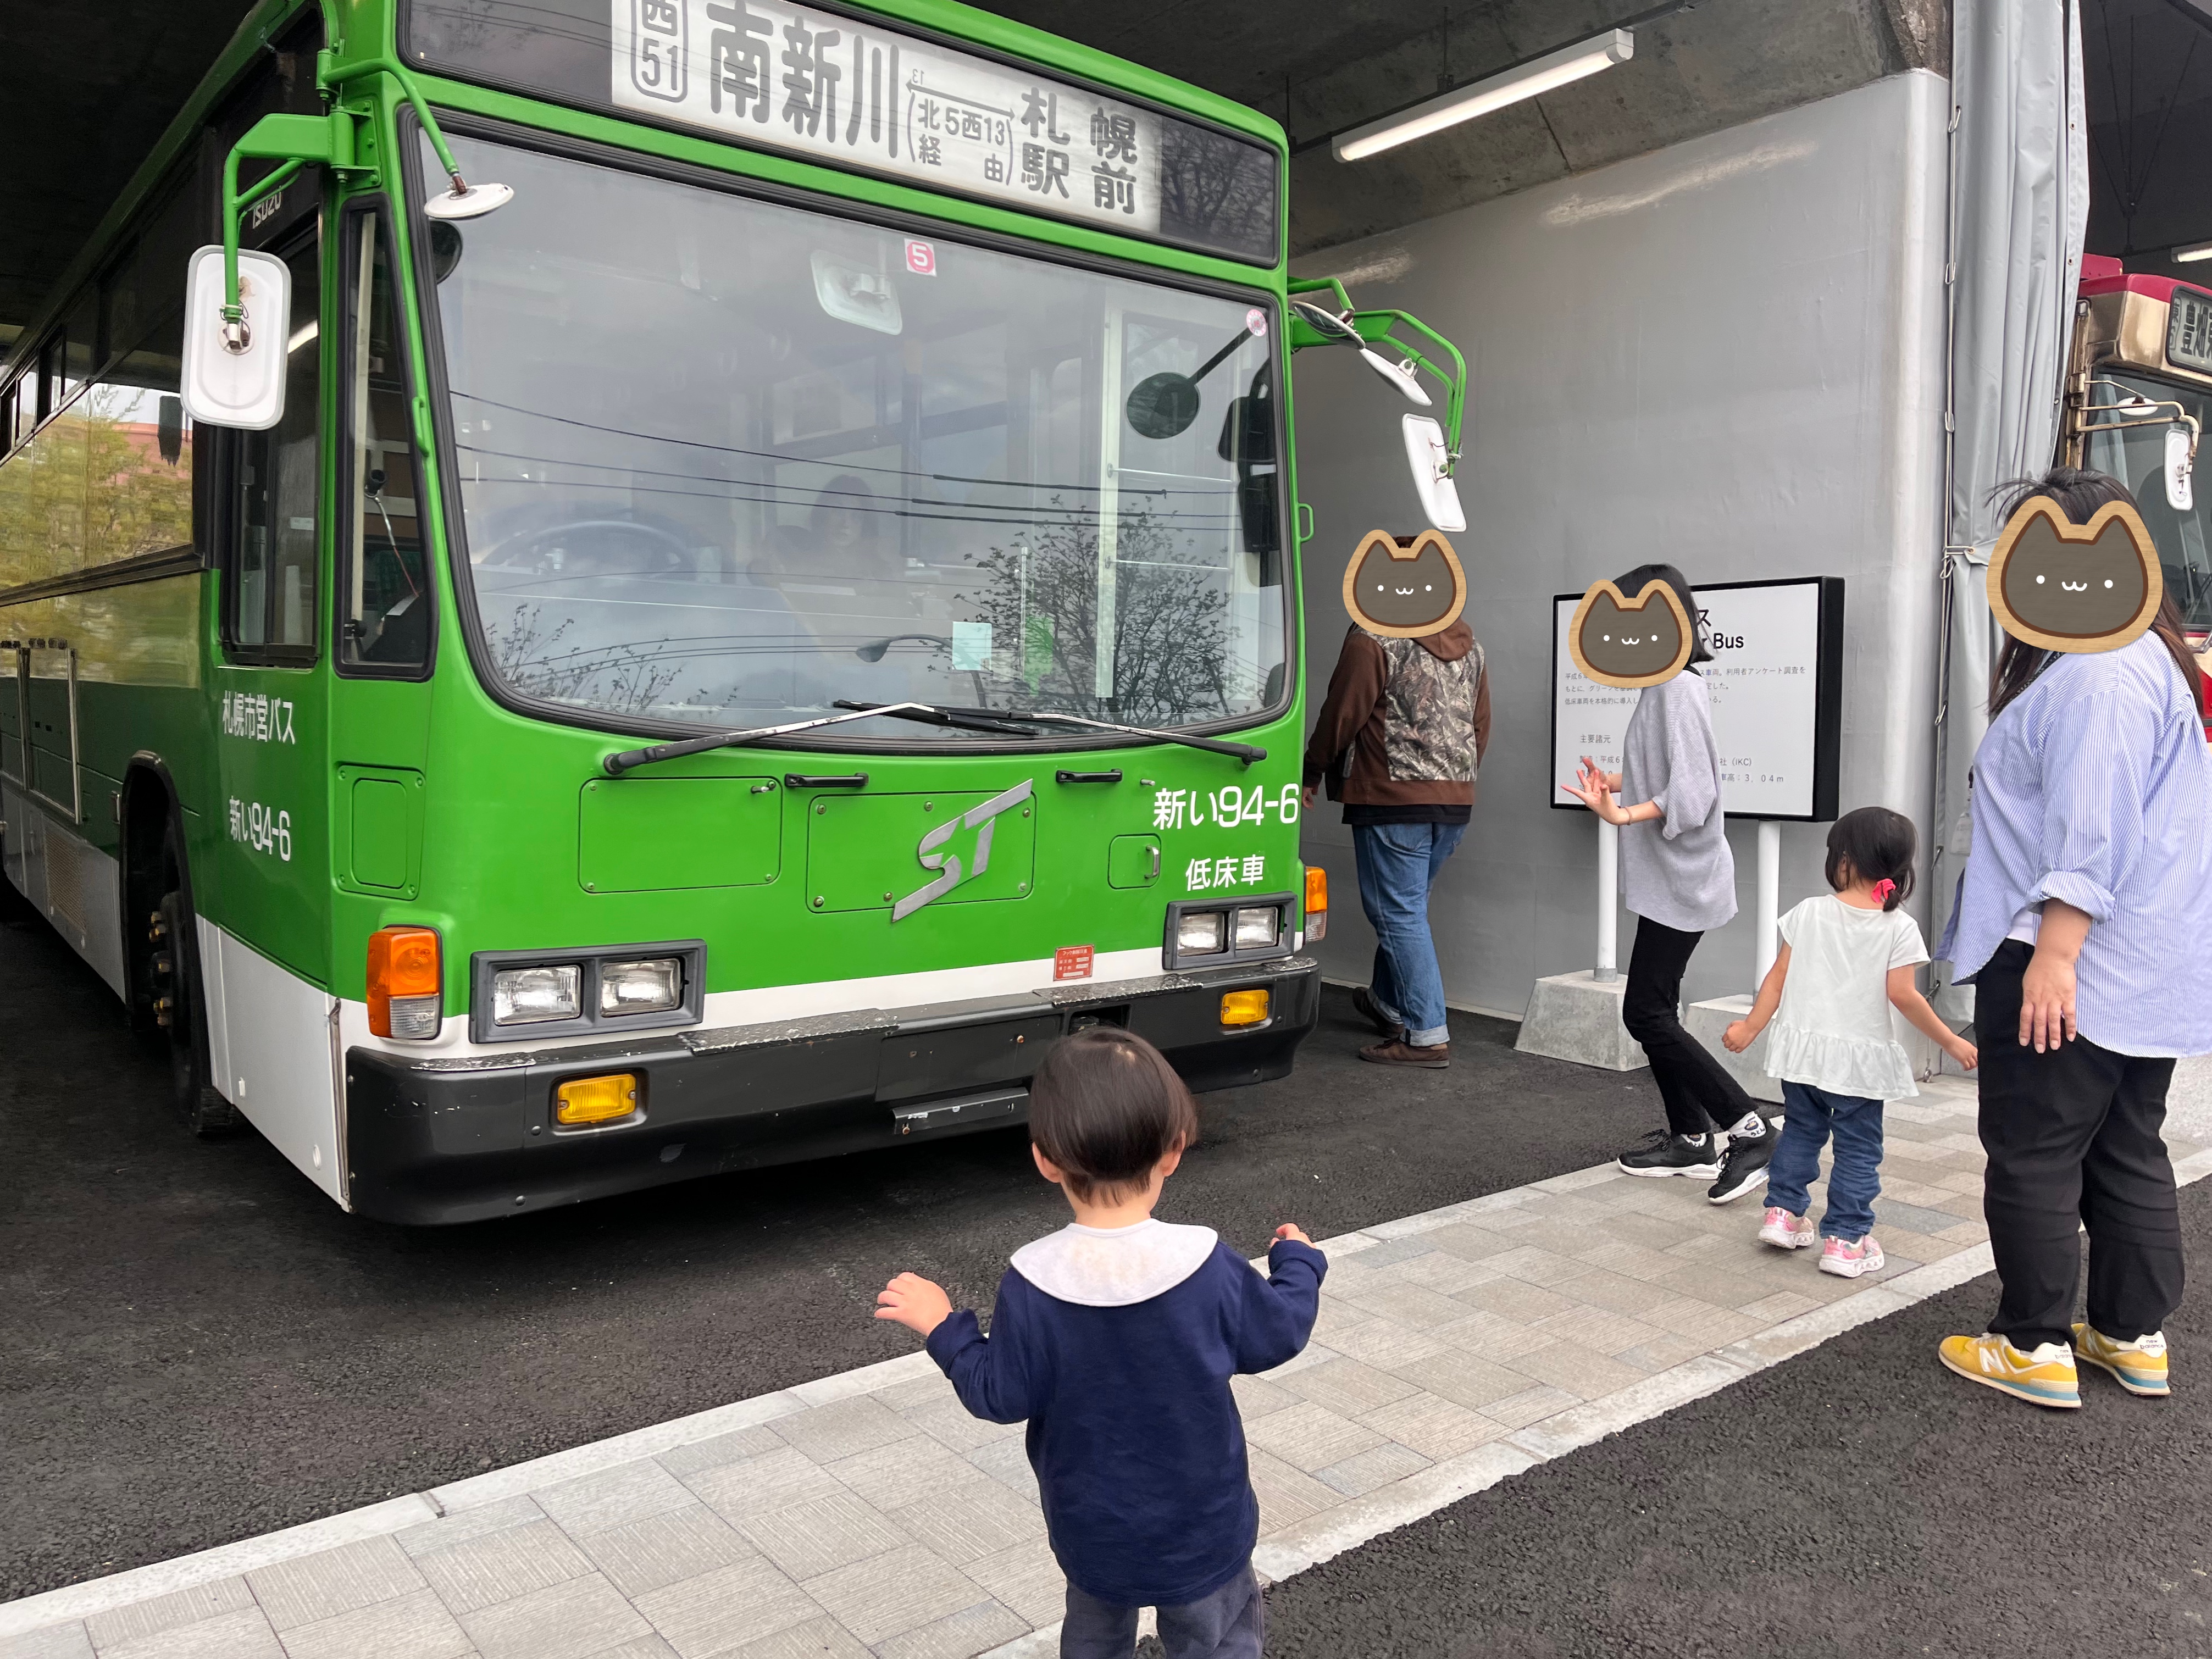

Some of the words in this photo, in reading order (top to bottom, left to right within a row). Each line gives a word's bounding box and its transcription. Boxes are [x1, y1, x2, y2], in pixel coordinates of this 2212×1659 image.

[641, 37, 678, 91] 51
[706, 0, 899, 158] 南新川
[1021, 87, 1138, 164] 札幌
[1021, 142, 1137, 214] 駅前
[253, 185, 282, 229] ISUZU
[912, 243, 928, 267] 5
[1714, 632, 1744, 649] Bus
[222, 689, 296, 745] 札幌市営バス
[1580, 734, 1611, 743] 主要諸元
[229, 795, 292, 862] 新い94-6
[1152, 783, 1300, 830] 新い94-6
[1185, 853, 1265, 892] 低床車
[1979, 1347, 2006, 1374] N
